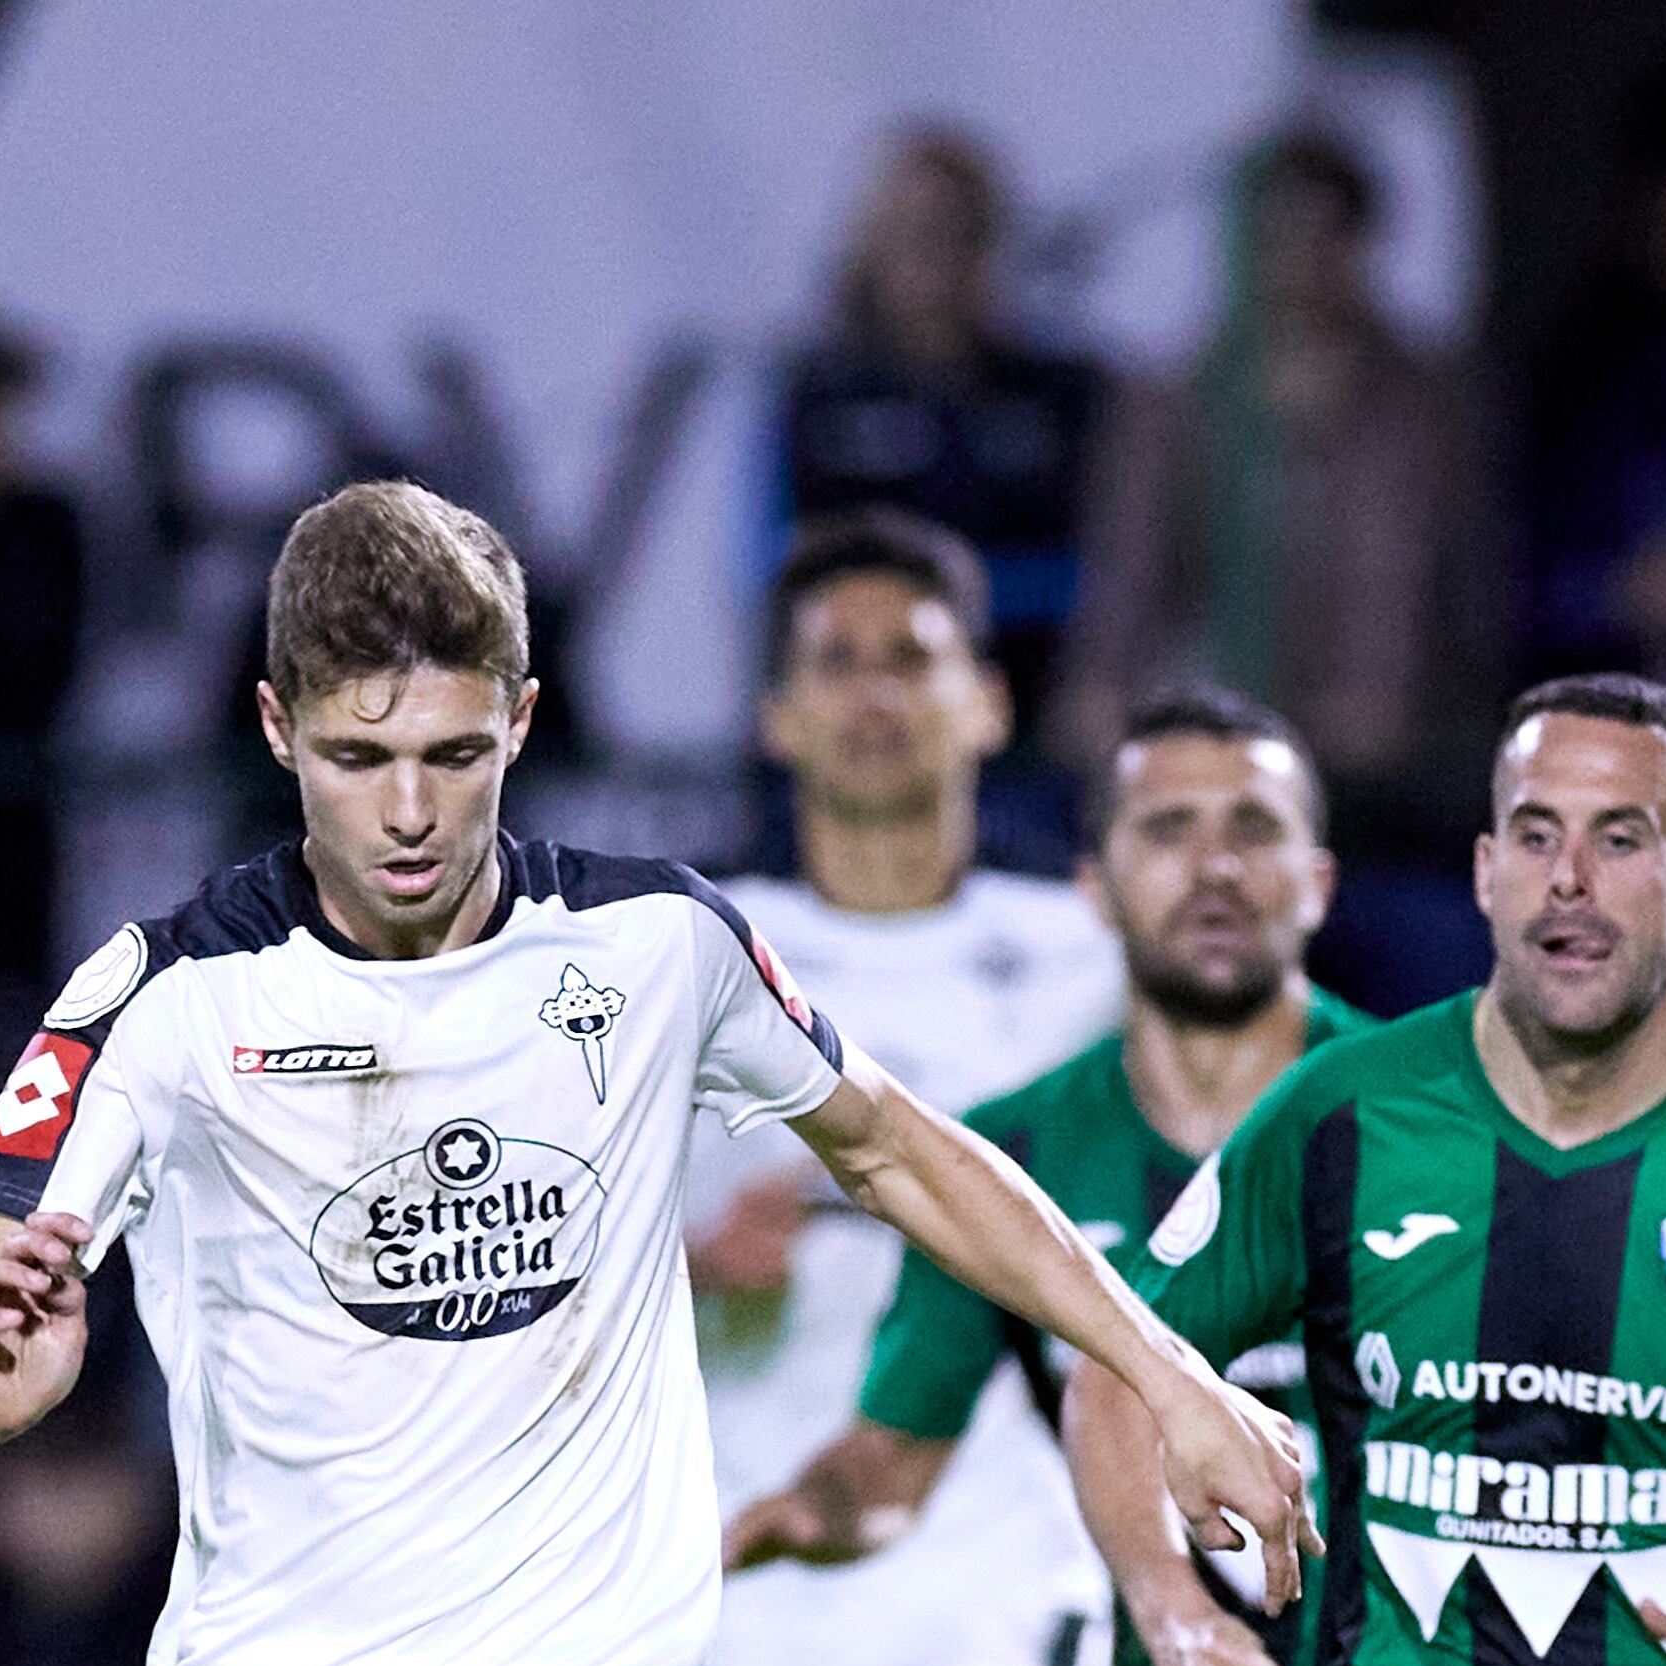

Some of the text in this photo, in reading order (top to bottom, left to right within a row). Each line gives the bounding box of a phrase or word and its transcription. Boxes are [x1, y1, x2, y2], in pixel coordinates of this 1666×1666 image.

[365, 1179, 567, 1242] Estrella
[372, 1229, 556, 1290] Galicia
[435, 1285, 500, 1332] 0,0
